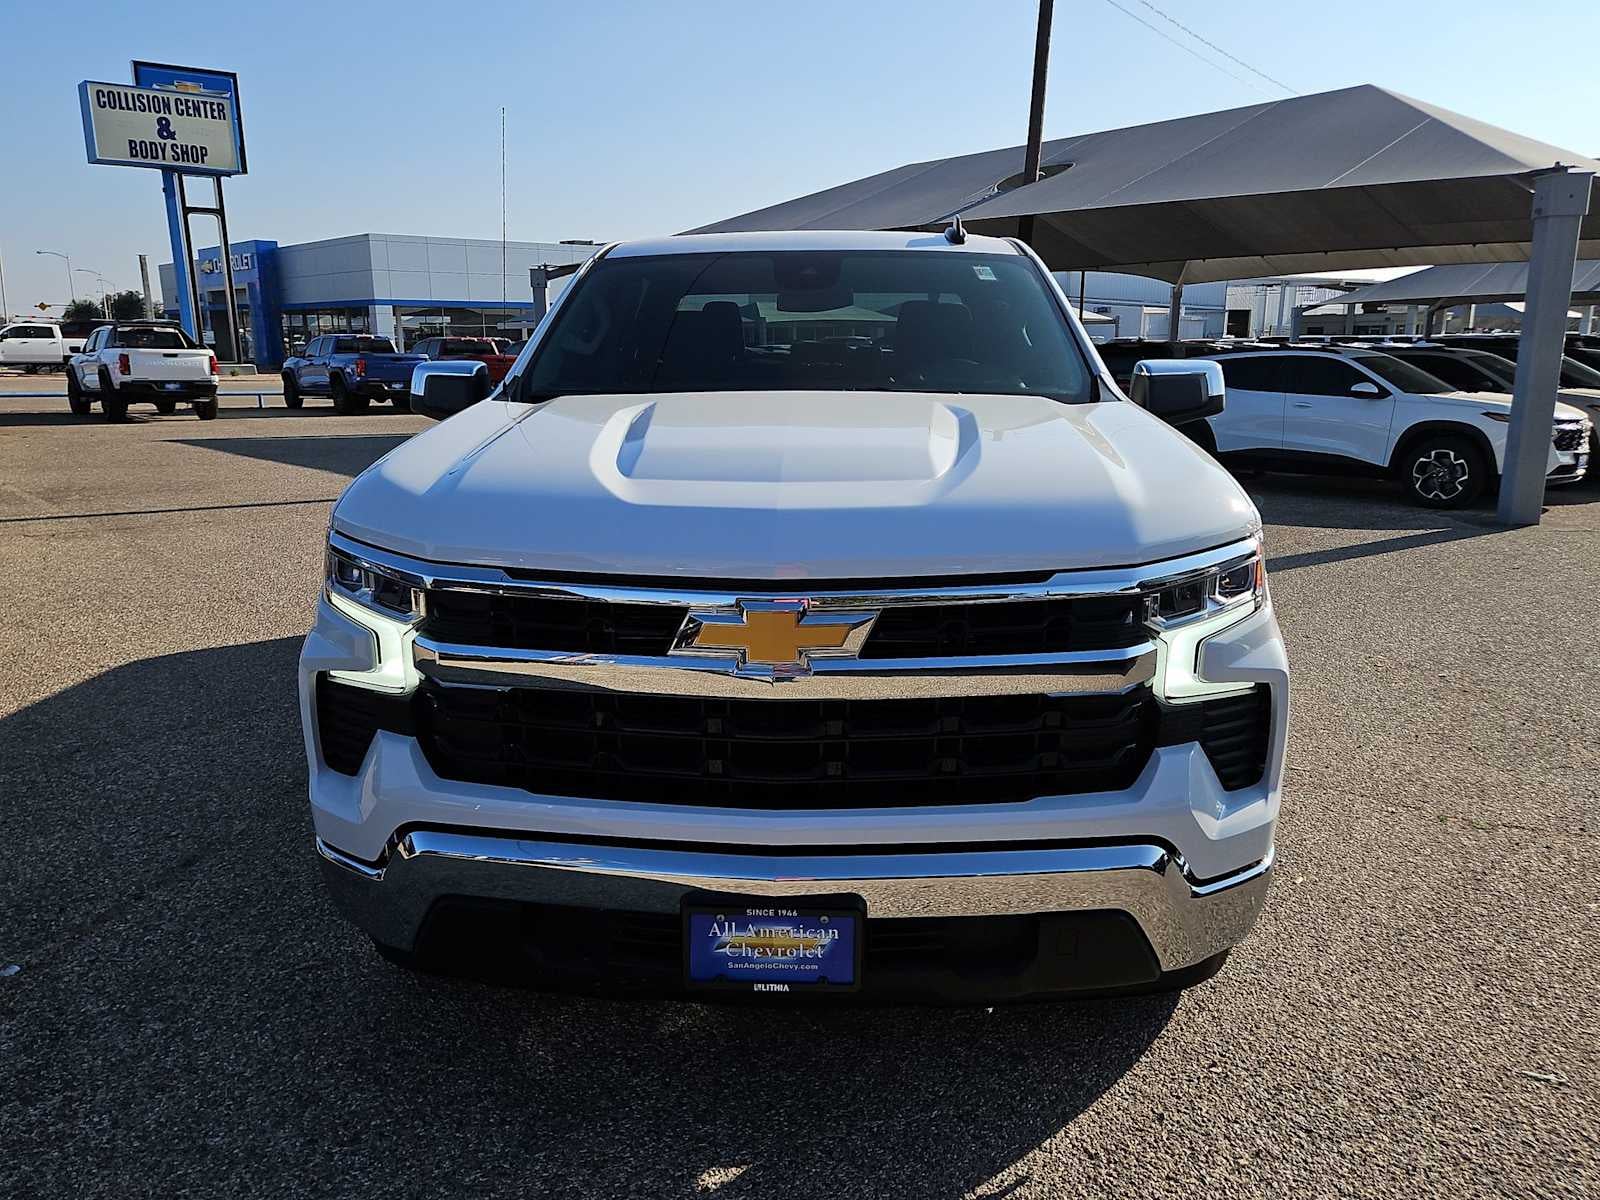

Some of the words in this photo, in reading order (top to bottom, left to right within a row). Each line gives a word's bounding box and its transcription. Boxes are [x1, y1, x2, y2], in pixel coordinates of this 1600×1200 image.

[96, 89, 171, 115] COLLISION
[175, 97, 226, 121] CENTER
[156, 116, 177, 141] &
[128, 139, 168, 161] BODY
[170, 144, 208, 164] SHOP
[213, 253, 252, 273] CHROLET
[746, 909, 775, 917] SINCE
[778, 909, 798, 917] 1946
[708, 922, 738, 938] All
[744, 924, 839, 940] American
[726, 942, 825, 960] Chevrolet
[727, 962, 819, 971] SanAngeloChevy.com
[761, 983, 790, 992] LITHIA
